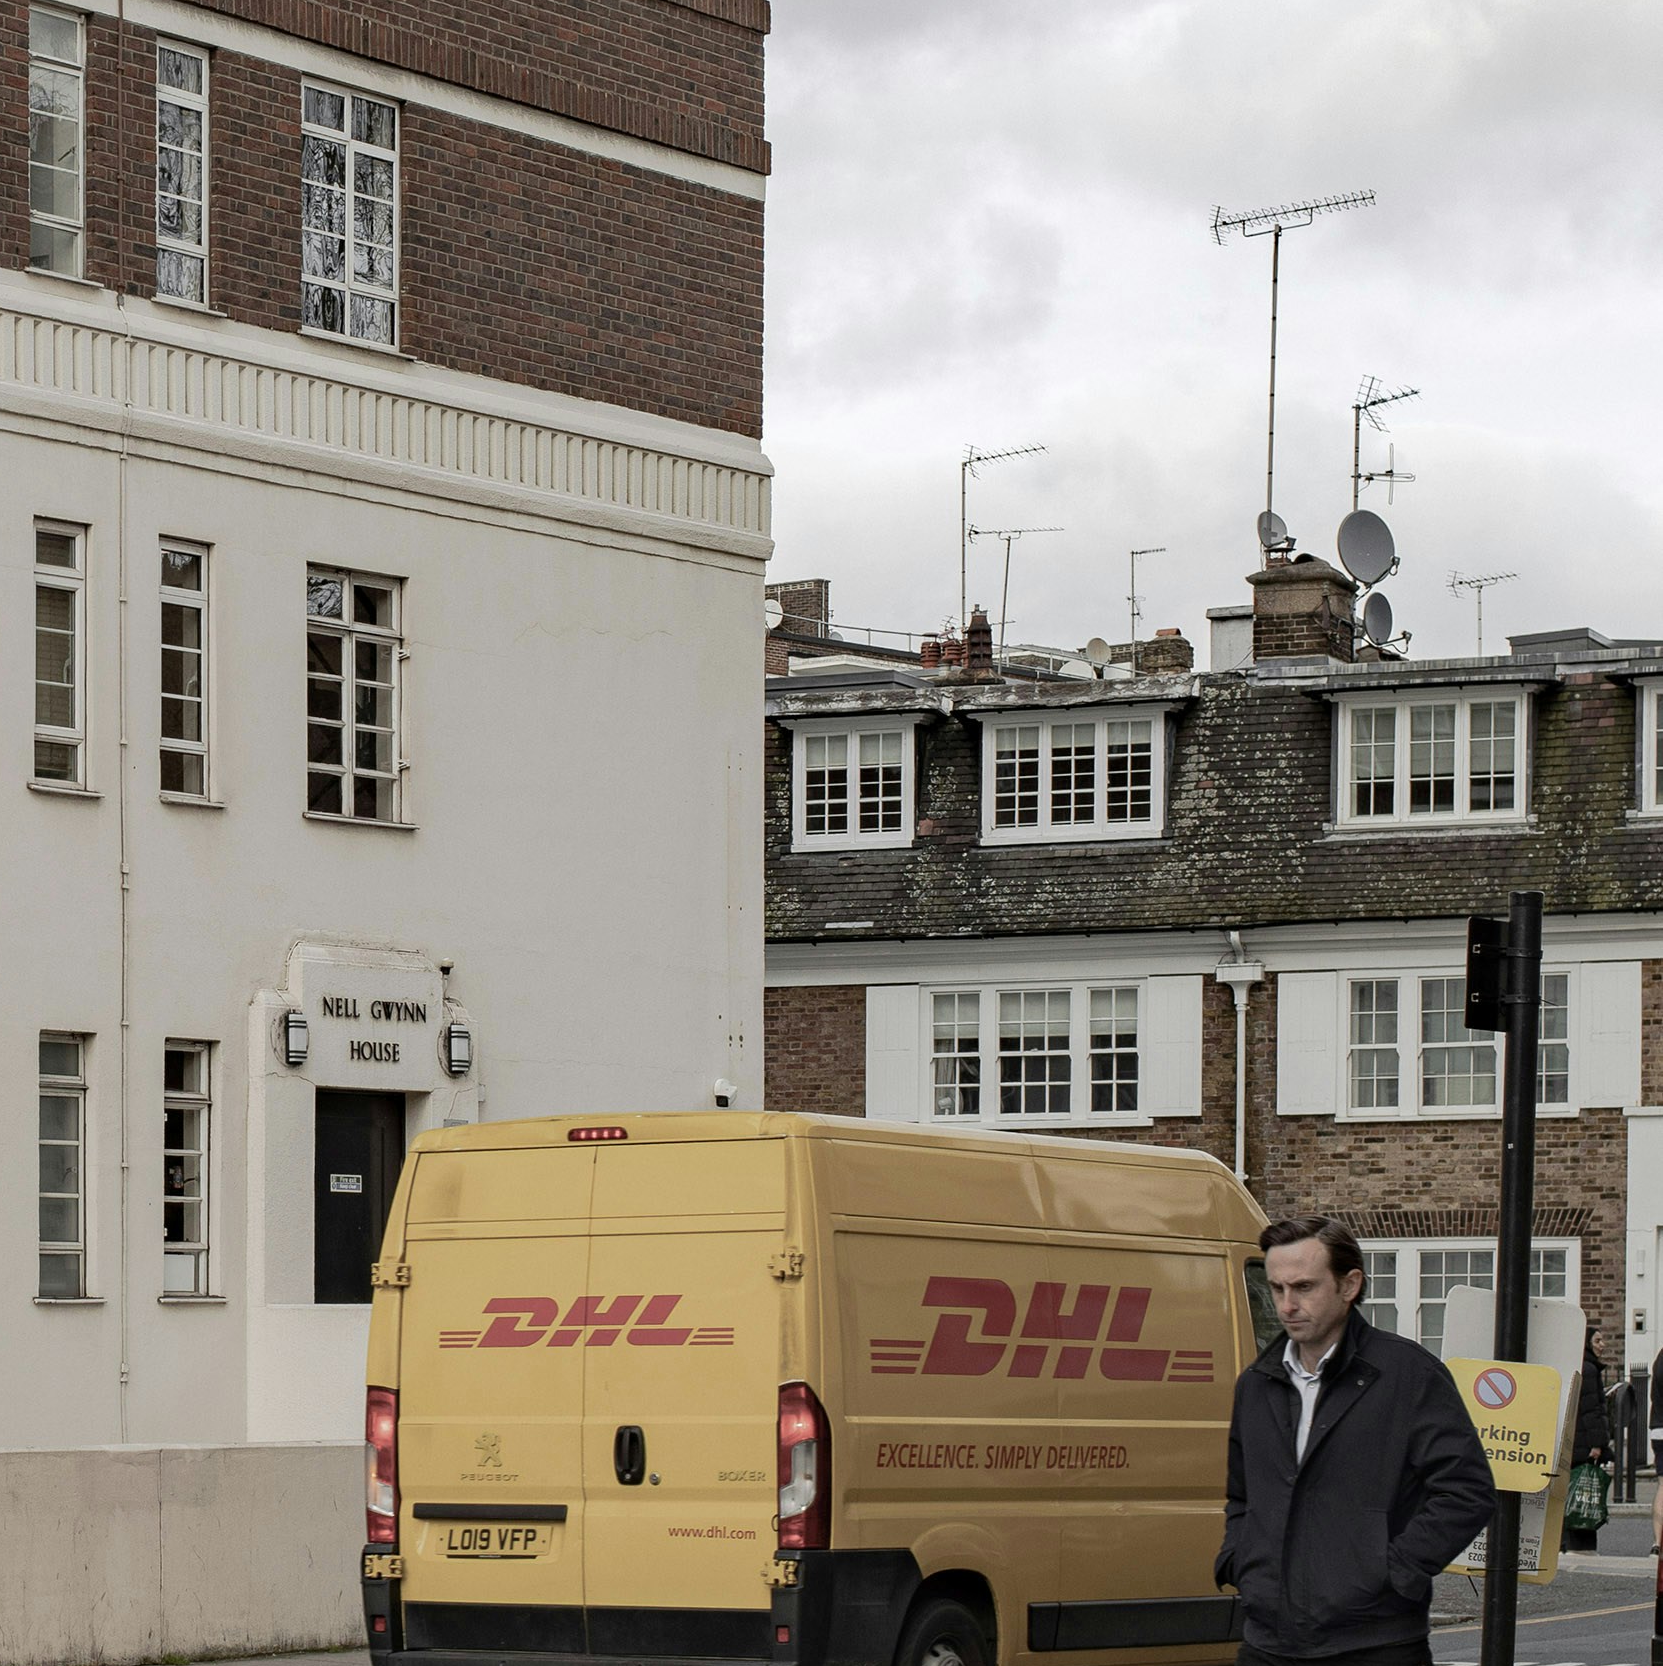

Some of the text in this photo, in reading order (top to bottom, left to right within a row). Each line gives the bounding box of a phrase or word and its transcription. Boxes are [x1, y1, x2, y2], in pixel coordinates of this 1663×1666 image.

[322, 996, 426, 1023] NELL GWYNN
[350, 1040, 400, 1063] HOUSE
[477, 1294, 694, 1348] DHL
[921, 1276, 1171, 1382] DHL
[1480, 1424, 1530, 1446] rking
[876, 1443, 1130, 1469] EXCELLENCE. SIMPLY DELIVERED.
[1485, 1447, 1547, 1465] ension
[460, 1473, 519, 1482] PEUGEOT
[718, 1471, 766, 1482] BOXER
[447, 1528, 538, 1551] LO19 VFP
[668, 1526, 756, 1540] www.dhl.com
[1473, 1541, 1538, 1558] Tue 023
